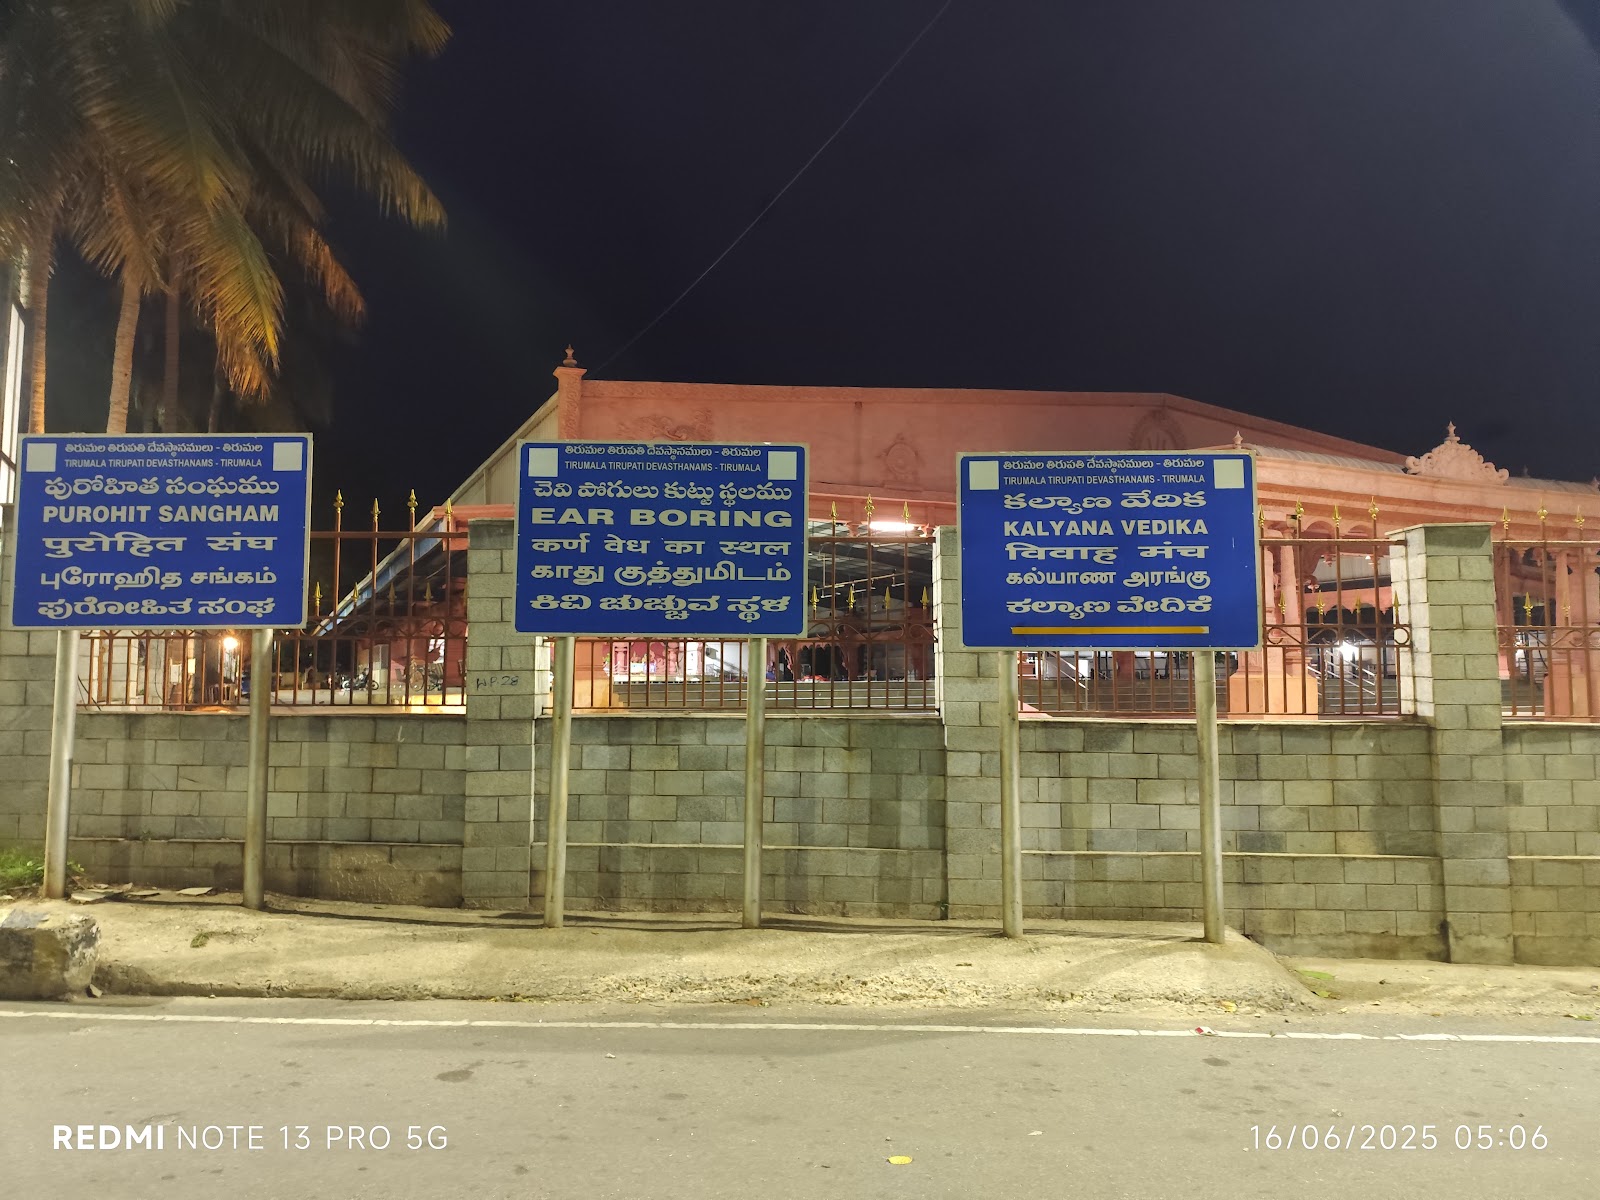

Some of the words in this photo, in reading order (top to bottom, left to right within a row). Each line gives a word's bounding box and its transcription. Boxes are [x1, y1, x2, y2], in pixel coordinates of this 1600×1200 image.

[147, 459, 213, 467] DEVASTHANAMS
[220, 459, 262, 467] TIRUMALA
[565, 461, 606, 470] TIRUMALA
[609, 462, 644, 470] TIRUPATI
[646, 462, 713, 471] DEVASTHANAMS
[720, 463, 761, 472] TIRUMALA
[45, 475, 159, 500] పురోహిత
[165, 475, 279, 498] సంఘము
[1004, 477, 1046, 485] TIRUMALA
[1048, 476, 1085, 484] TIRUPATI
[1087, 476, 1155, 484] DEVASTHANAMS
[1162, 475, 1205, 483] TIRUMALA
[533, 481, 572, 498] చెవి
[663, 482, 714, 505] కుట్టు
[1003, 493, 1112, 514] కల్యాణ
[1121, 490, 1207, 508] వేదిక
[43, 506, 151, 523] PUROHIT
[158, 505, 278, 522] SANGHAM
[532, 508, 614, 525] EAR
[631, 509, 792, 527] BORING
[1004, 521, 1114, 536] KALYANA
[1121, 519, 1208, 535] VEDIKA
[42, 532, 187, 558] पुरोहित
[206, 532, 277, 551] संघ
[532, 533, 590, 553] कर्ण
[604, 534, 650, 554] वेध
[664, 541, 705, 554] का
[719, 542, 791, 555] स्थल
[1005, 542, 1118, 564] विवाह
[1138, 541, 1209, 559] मंच
[41, 566, 182, 590] புரோஹித
[190, 566, 277, 585] சங்கம்
[531, 565, 603, 585] காது
[614, 560, 791, 586] குத்துமிடம்
[1006, 567, 1116, 585] கல்யாண
[1123, 566, 1211, 589] அரங்கு
[38, 597, 193, 619] ಪುರೋಹಿತ
[530, 594, 592, 610] ಕಿವಿ
[600, 594, 720, 620] ಚುಚ್ಚುವ
[1006, 597, 1110, 620] ಕಲ್ಯಾಣ
[1117, 596, 1212, 613] ವೇದಿಕೆ
